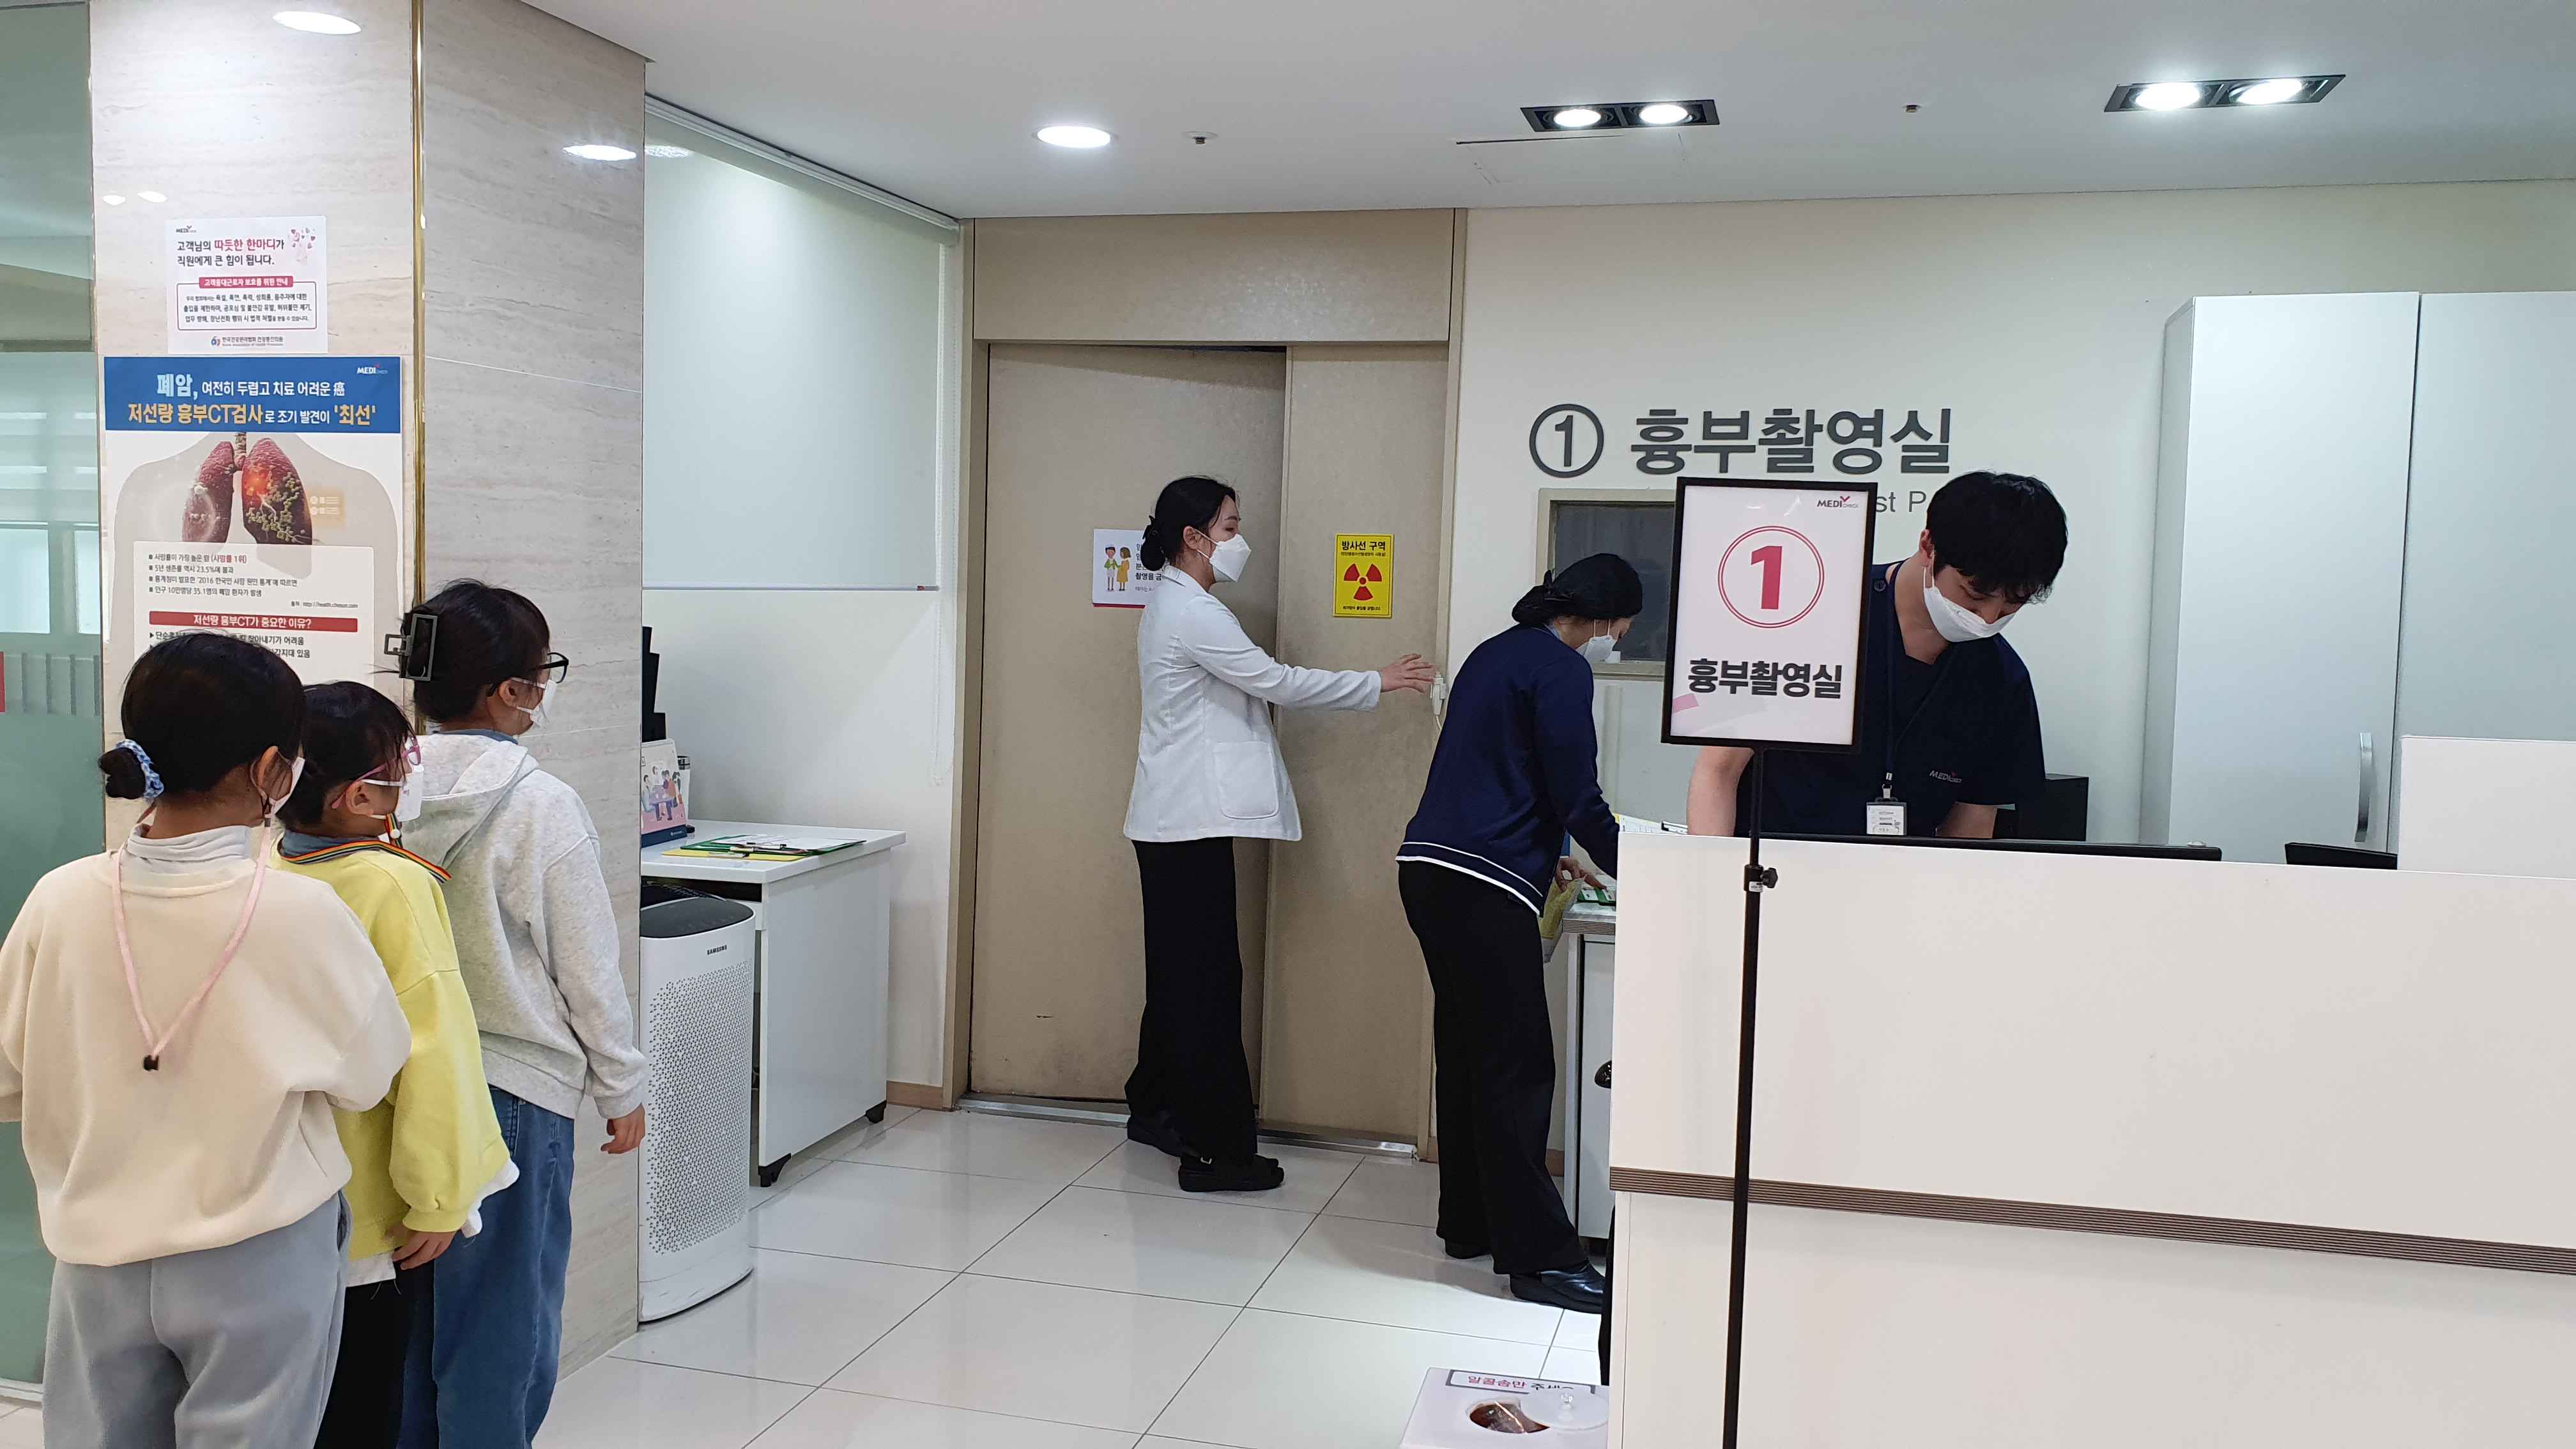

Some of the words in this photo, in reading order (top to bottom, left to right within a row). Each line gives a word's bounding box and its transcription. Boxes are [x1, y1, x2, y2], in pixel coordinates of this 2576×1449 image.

[177, 241, 211, 252] 고객님의
[246, 238, 284, 251] 한마디가
[177, 256, 212, 266] 직원에게
[215, 256, 223, 266] 큰
[226, 255, 243, 266] 힘이
[246, 254, 275, 266] 됩니다.
[204, 279, 244, 287] 고객응대근로자
[245, 278, 262, 286] 보호를
[263, 278, 275, 286] 위한
[276, 277, 288, 286] 안내
[157, 373, 198, 401] 폐암,
[202, 381, 234, 396] 여전히
[237, 381, 270, 396] 두렵고
[273, 381, 294, 396] 치료
[297, 381, 330, 396] 어려운
[128, 403, 174, 424] 저선량
[277, 410, 297, 424] 조기
[300, 410, 330, 424] 발견이
[334, 404, 376, 425] '최선'
[1630, 408, 1952, 475] 흉부촬영실
[1342, 540, 1366, 551] 방사선
[1369, 541, 1386, 551] 구역
[178, 554, 190, 562] 가장
[1135, 572, 1154, 581] 촬영을
[193, 615, 218, 626] 저선량
[261, 617, 286, 628] 중요한
[288, 618, 312, 629] 이유?
[296, 649, 310, 659] 있음
[1687, 658, 1843, 699] 흉부촬영실
